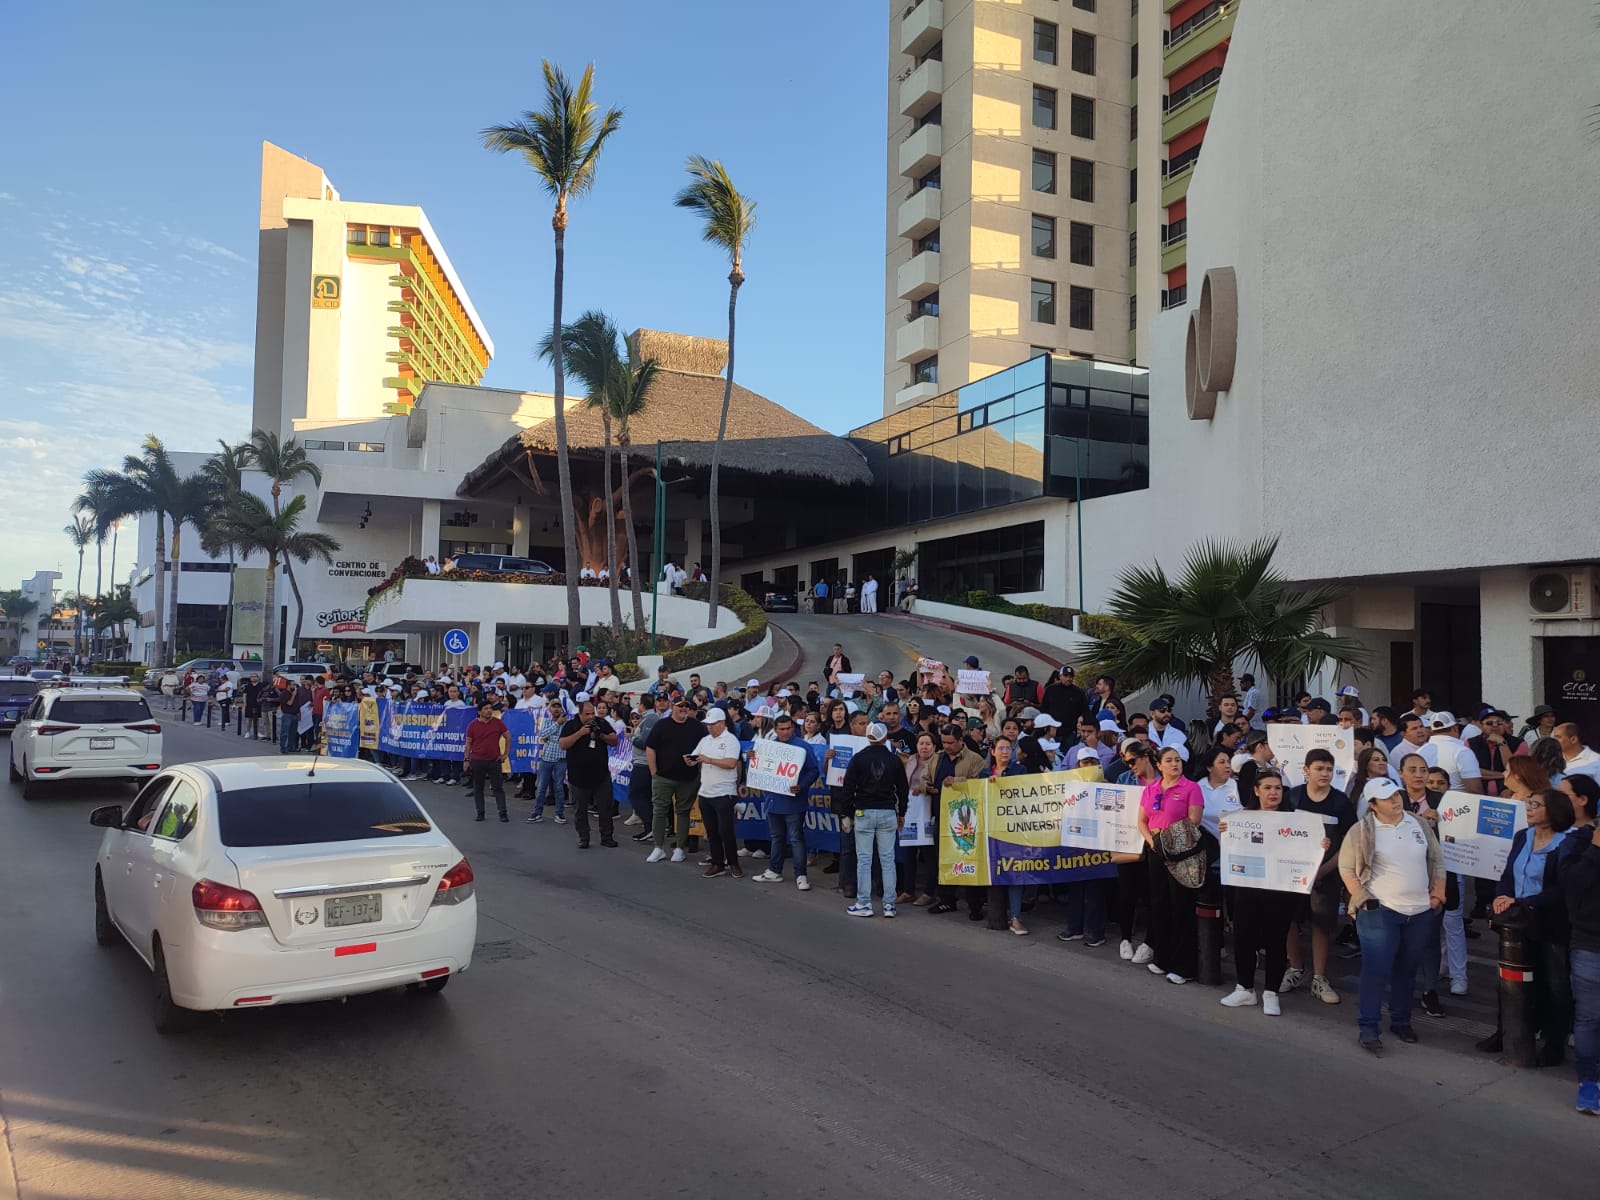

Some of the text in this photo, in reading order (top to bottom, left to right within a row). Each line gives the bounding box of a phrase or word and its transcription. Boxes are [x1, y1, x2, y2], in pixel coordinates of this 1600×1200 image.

[328, 570, 386, 578] CONVENCIONES
[316, 608, 356, 628] Señor
[776, 761, 798, 778] NO
[1000, 784, 1065, 799] POR LA DEFE
[997, 802, 1064, 816] DE LA AUTON
[1454, 805, 1470, 817] UAS
[1007, 820, 1062, 832] UNIVERSIT
[996, 857, 1050, 875] ¡Vamos
